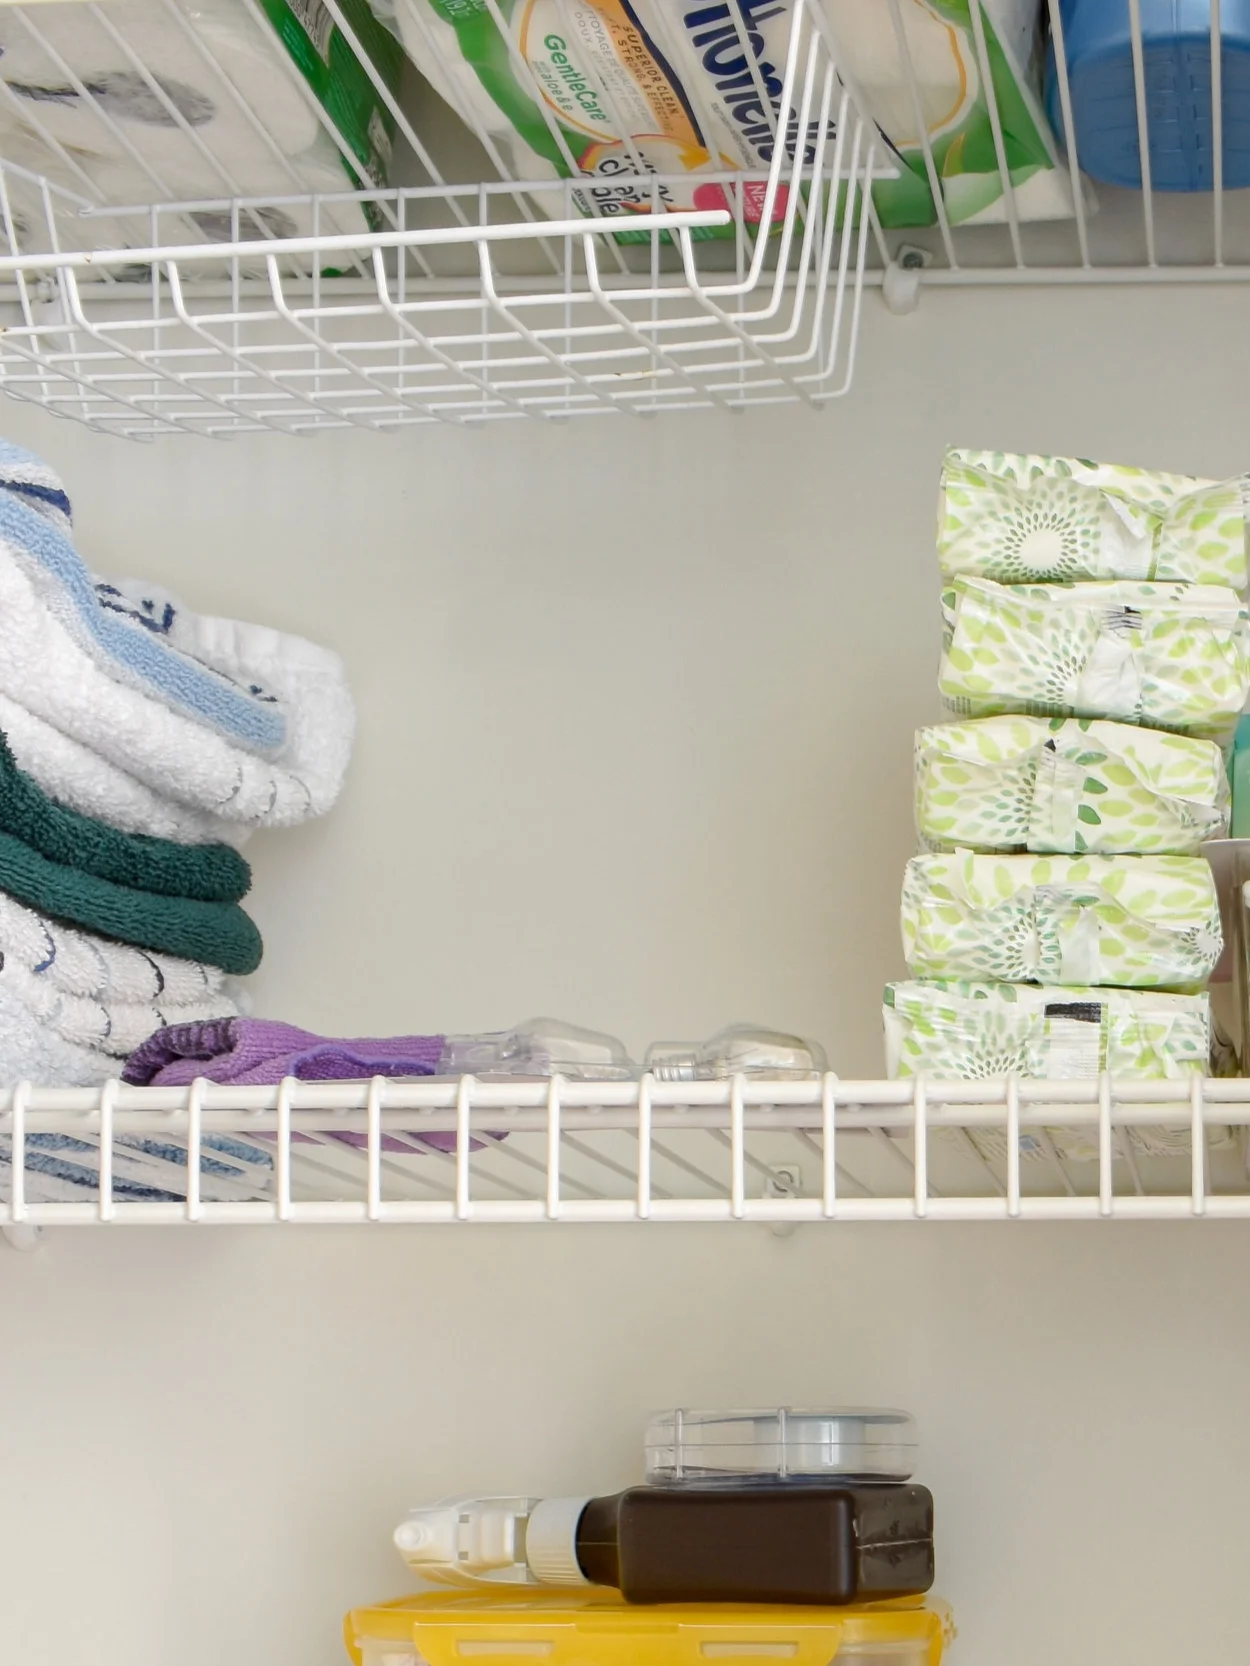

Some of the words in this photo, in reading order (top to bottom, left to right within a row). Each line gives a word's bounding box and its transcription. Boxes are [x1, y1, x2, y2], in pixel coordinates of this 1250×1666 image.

[543, 34, 610, 122] GentleCare
[623, 26, 662, 83] SUPERIOR
[656, 84, 680, 115] CLEAN
[599, 159, 641, 204] clan
